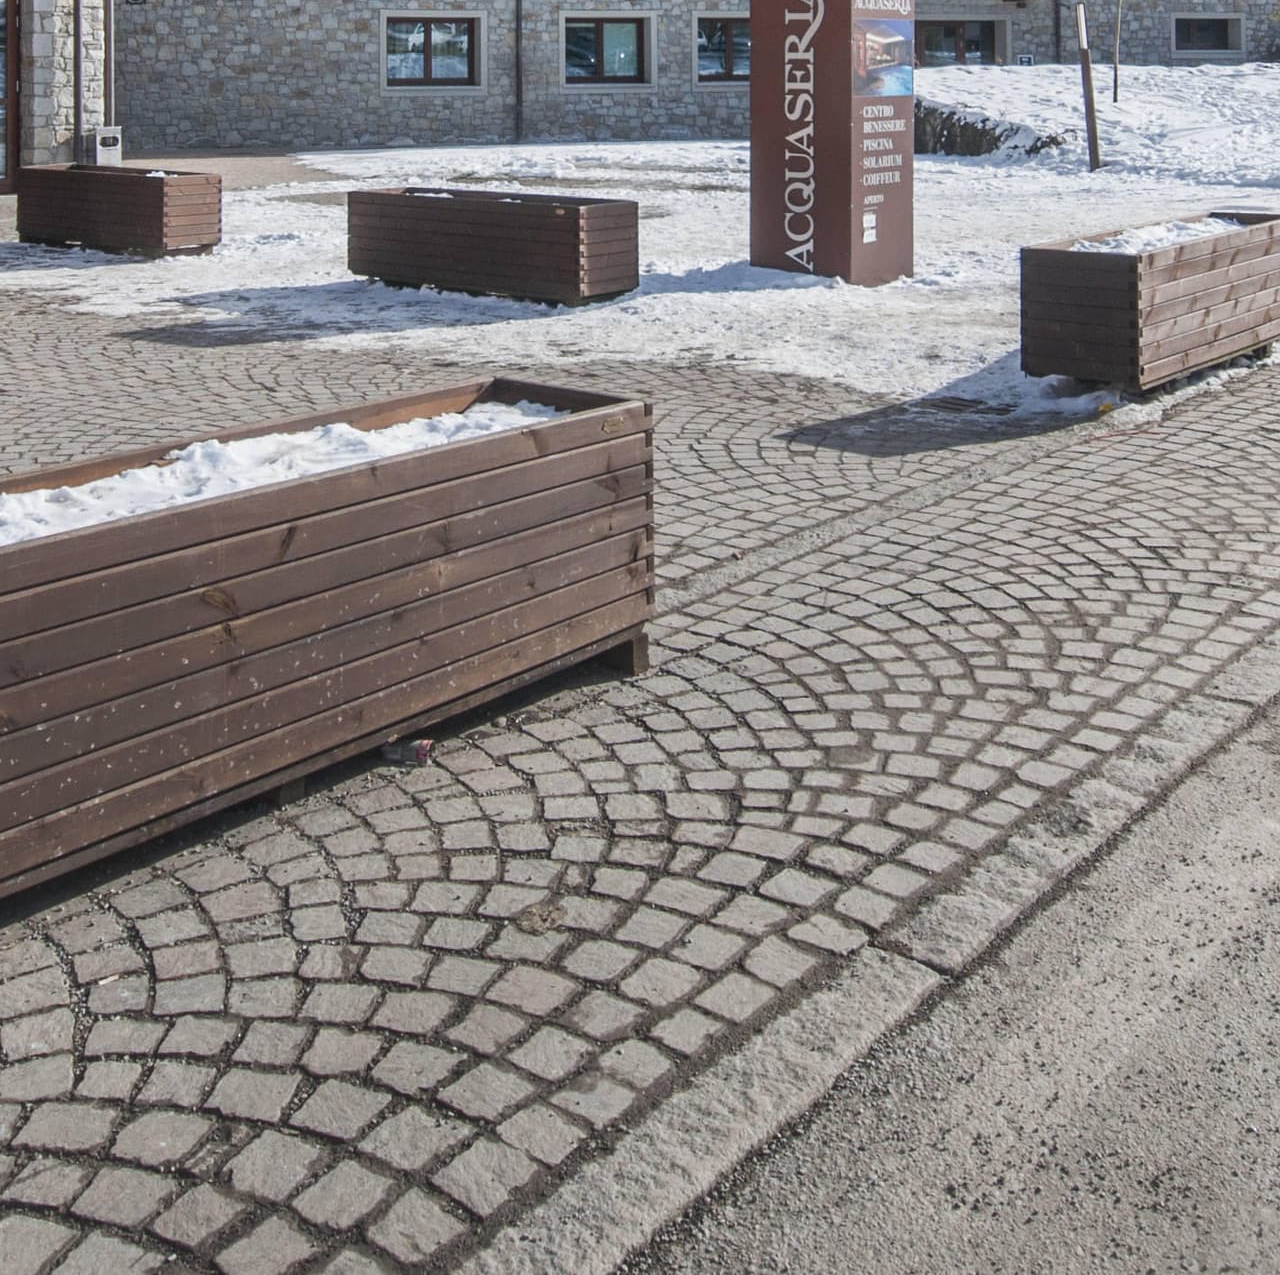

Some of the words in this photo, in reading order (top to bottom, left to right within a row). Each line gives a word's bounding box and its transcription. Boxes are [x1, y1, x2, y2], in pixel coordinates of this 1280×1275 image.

[863, 105, 894, 117] CENTRO
[863, 119, 906, 133] BENESSERE
[863, 138, 893, 151] PISCINA
[863, 154, 902, 169] SOLARIUM
[863, 171, 901, 185] COIFFEUR
